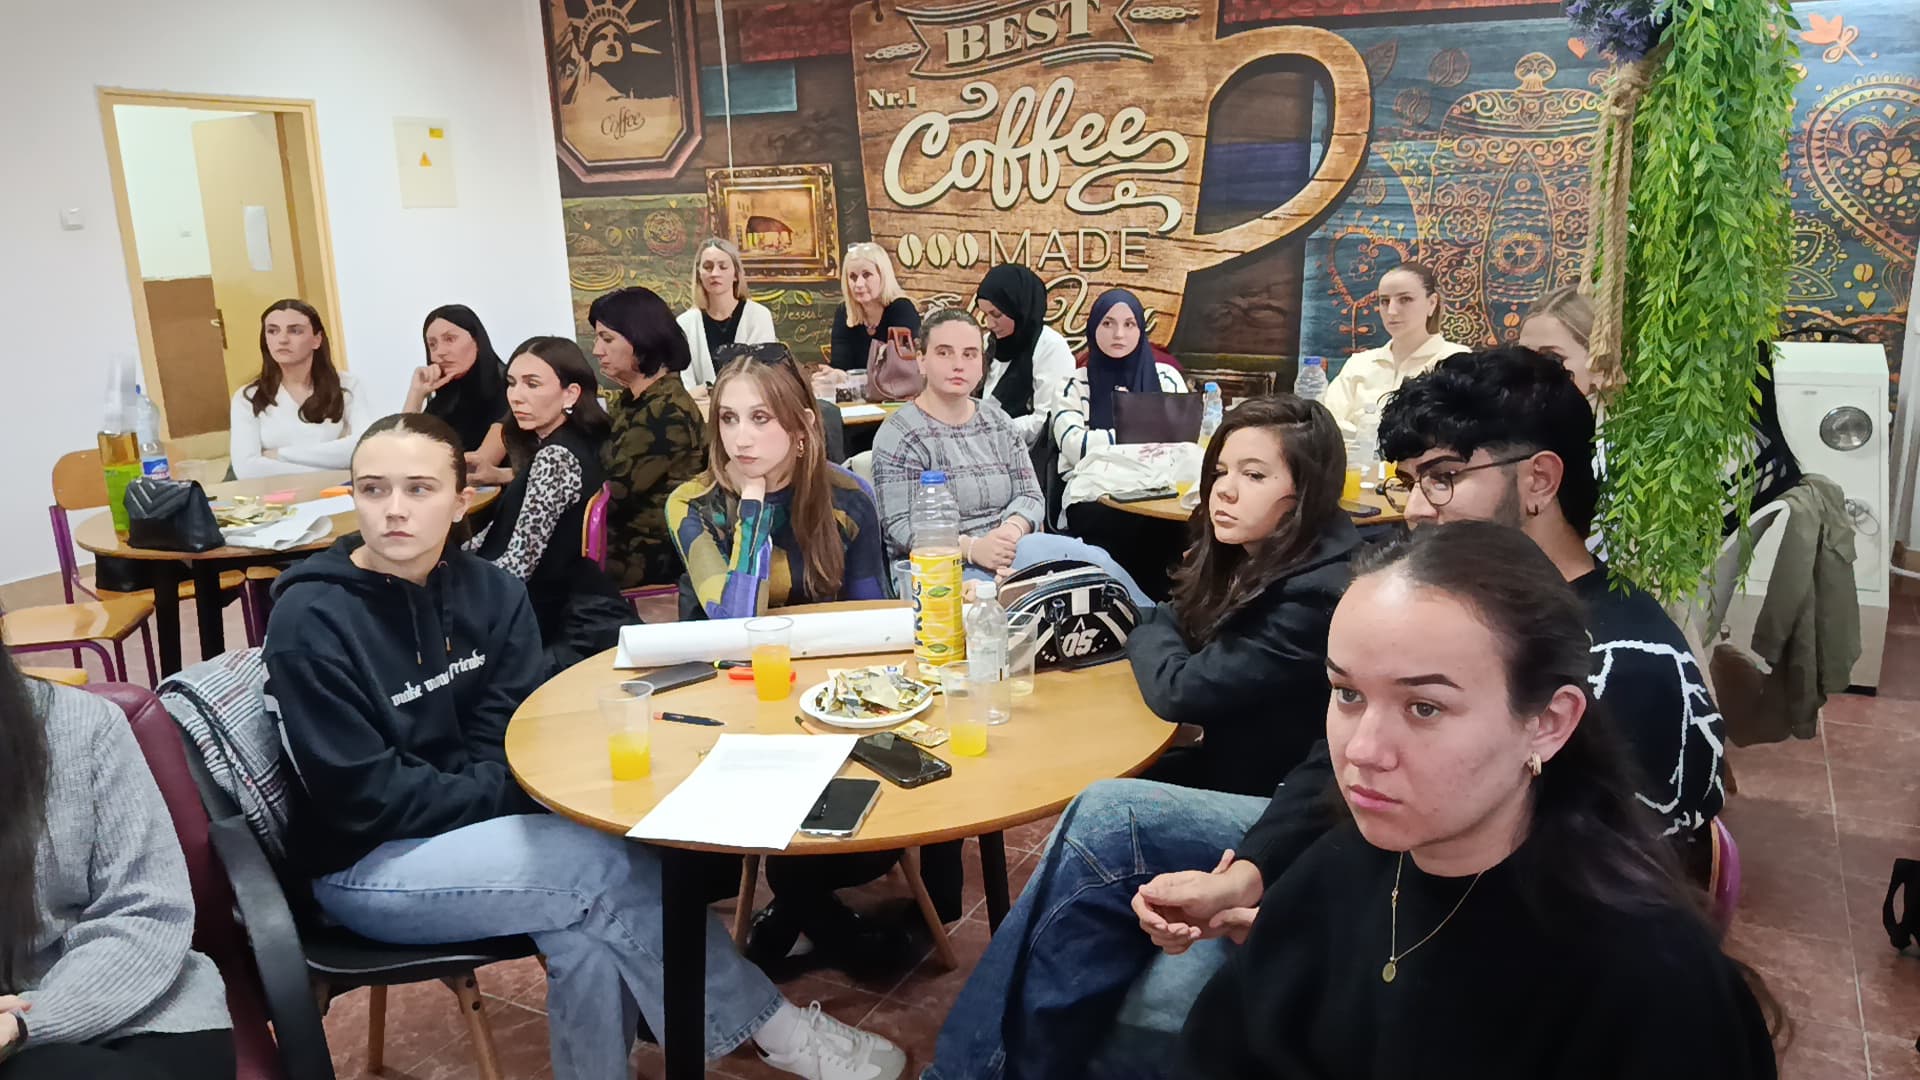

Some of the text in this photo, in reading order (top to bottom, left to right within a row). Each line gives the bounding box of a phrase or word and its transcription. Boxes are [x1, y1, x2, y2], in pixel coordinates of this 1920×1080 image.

[945, 0, 1100, 66] BEST
[600, 106, 646, 140] Coffee
[884, 77, 1188, 232] Coffee
[989, 227, 1150, 273] MADE
